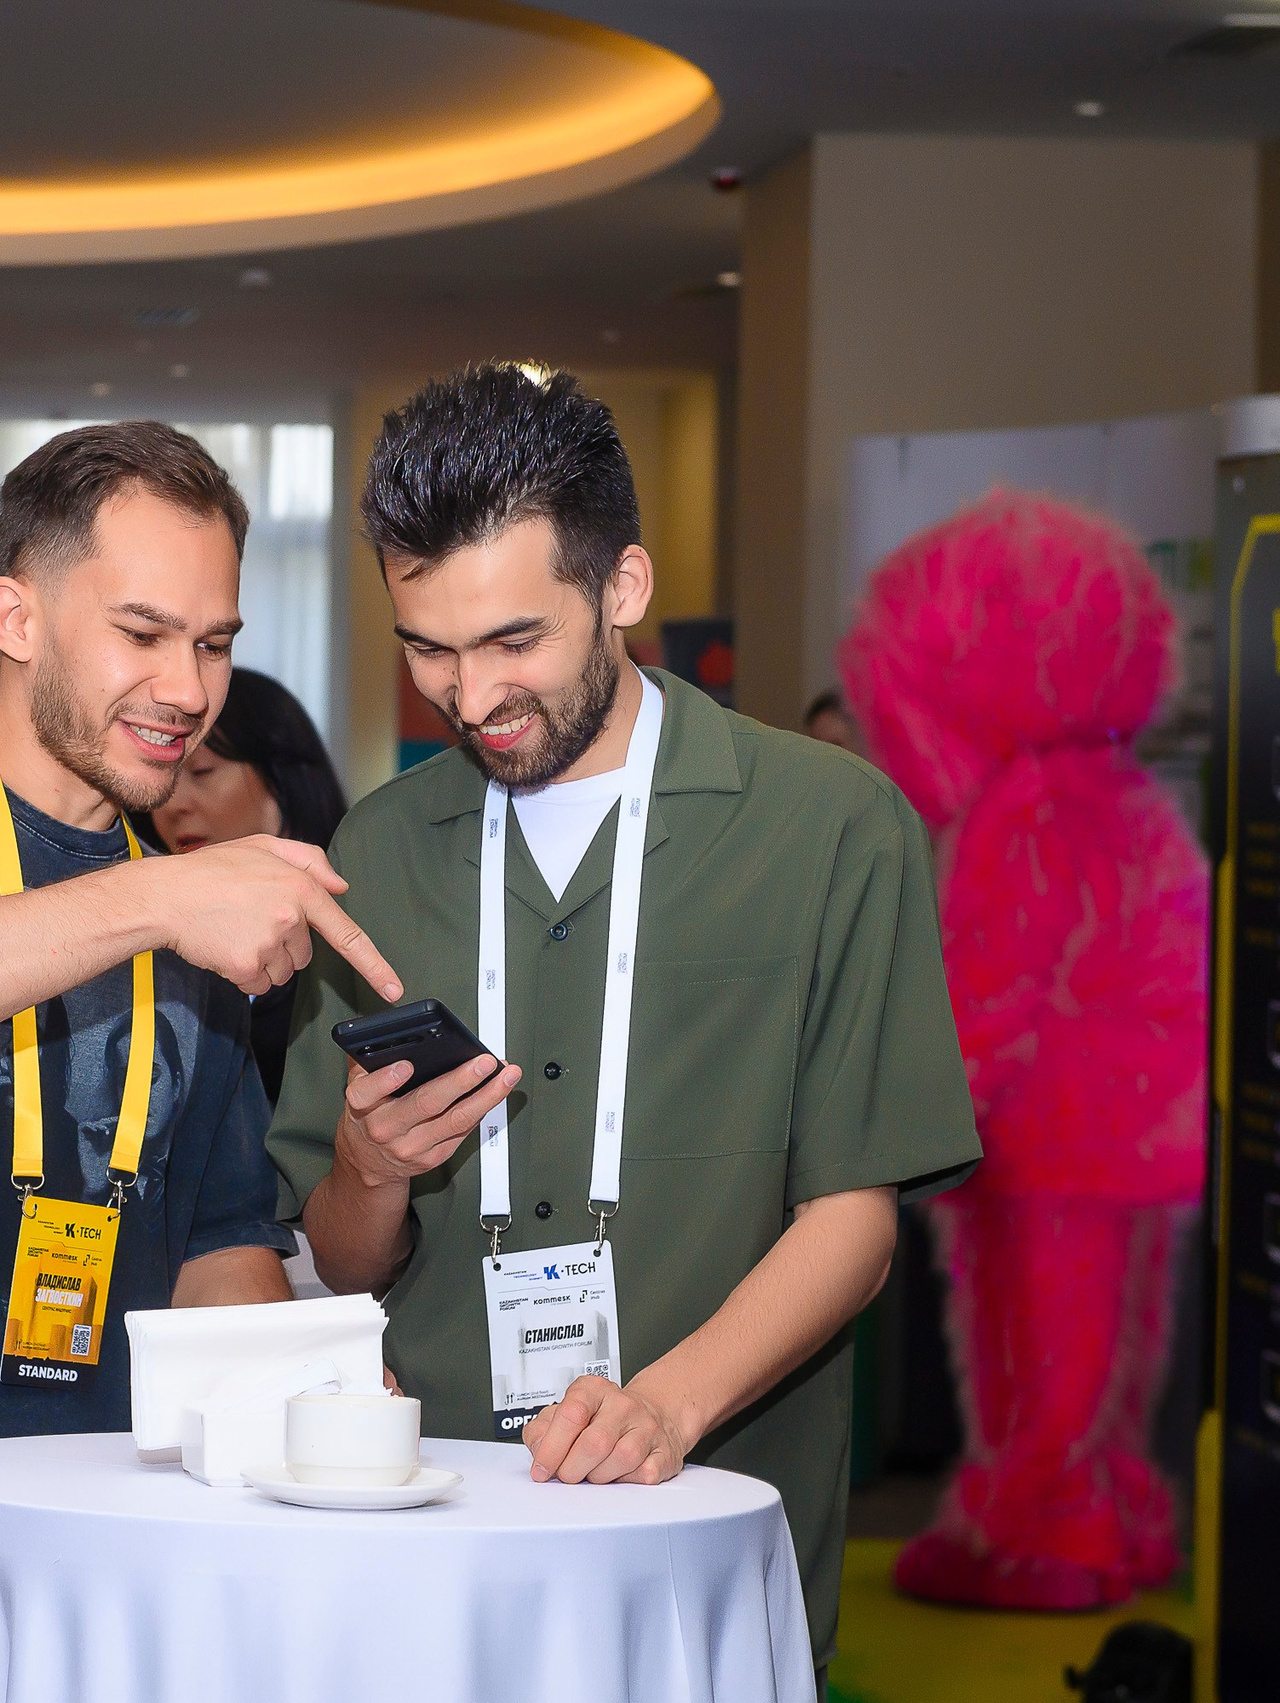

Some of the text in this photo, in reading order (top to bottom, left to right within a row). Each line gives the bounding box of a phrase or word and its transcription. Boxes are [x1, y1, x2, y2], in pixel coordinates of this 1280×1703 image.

[36, 1272, 82, 1291] ВЛАДИСЛАВ
[525, 1323, 584, 1344] СТАНИСЛАВ
[18, 1364, 78, 1382] STANDARD
